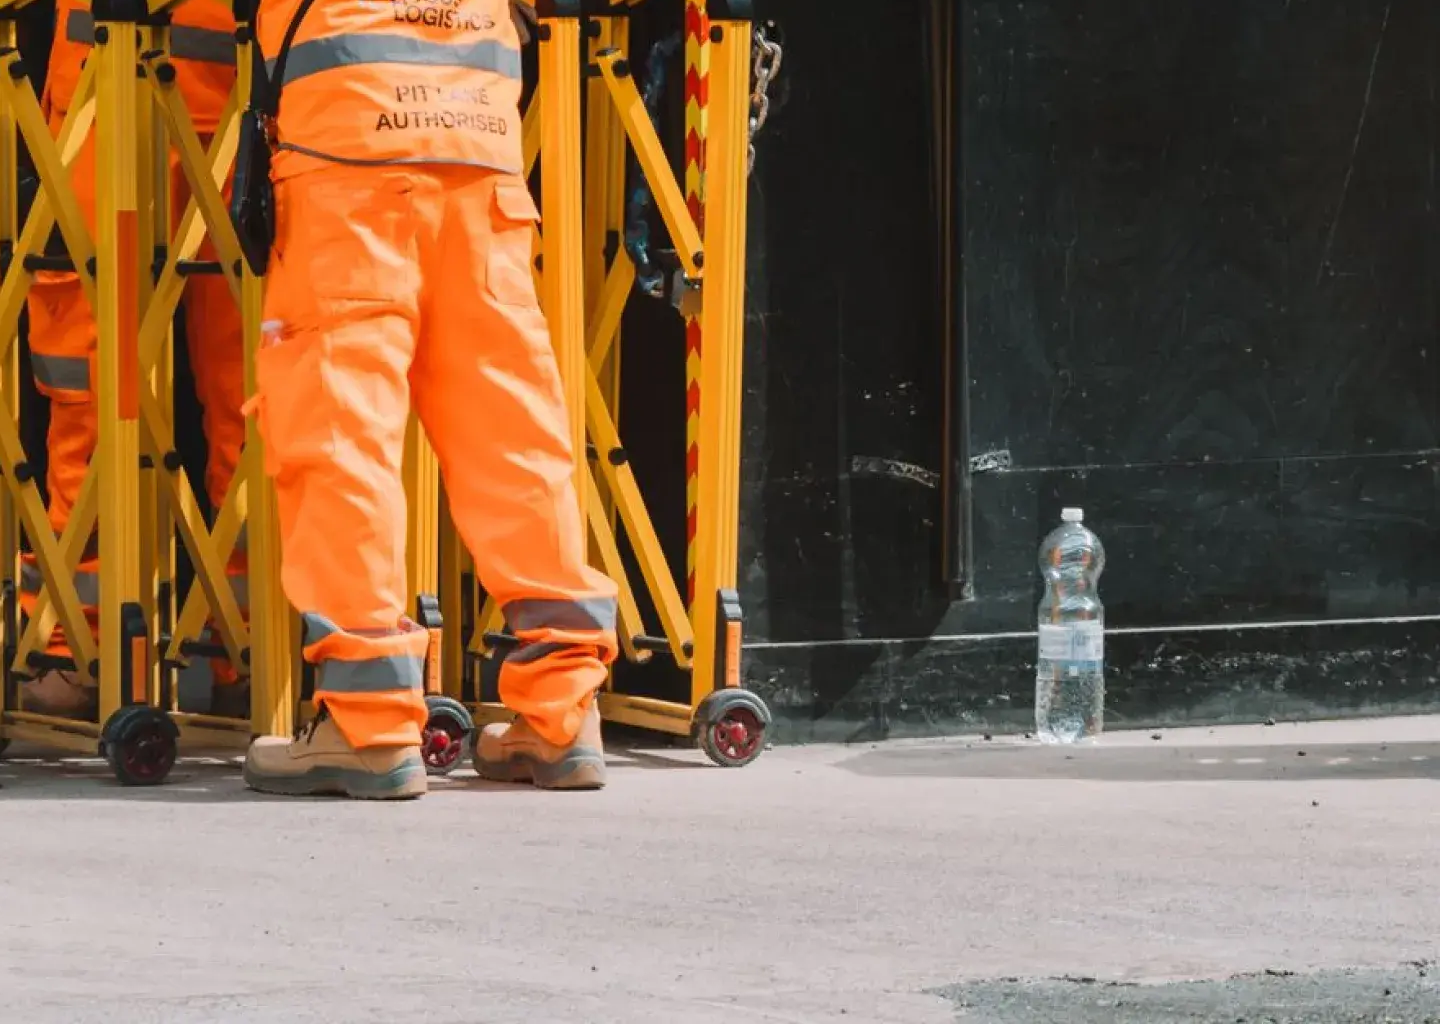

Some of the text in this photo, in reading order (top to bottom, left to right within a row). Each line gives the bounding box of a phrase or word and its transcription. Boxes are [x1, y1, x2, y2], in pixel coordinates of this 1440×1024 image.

[394, 5, 496, 32] LOGISTICS
[396, 85, 428, 103] PIT
[375, 111, 508, 136] AUTHORISED
